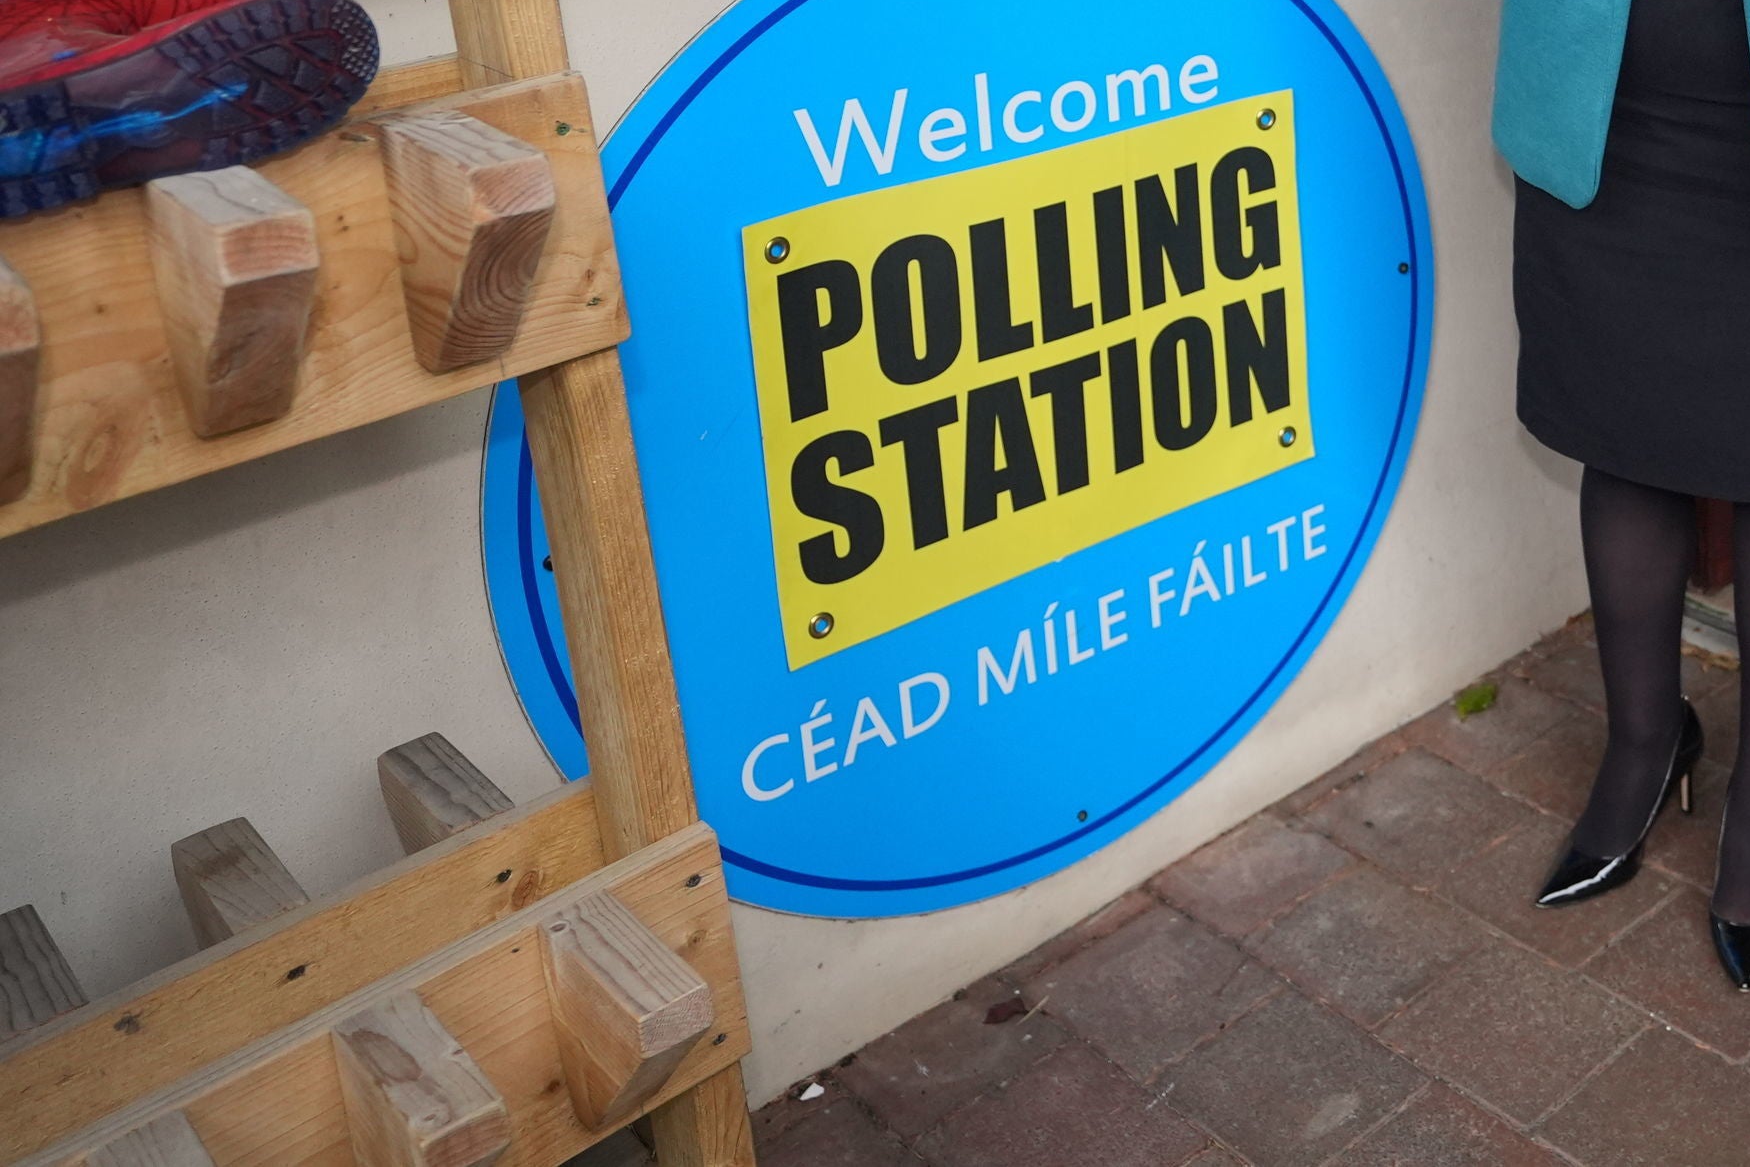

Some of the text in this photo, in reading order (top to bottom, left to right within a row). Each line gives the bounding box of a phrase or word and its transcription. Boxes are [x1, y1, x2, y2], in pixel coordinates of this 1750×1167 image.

[793, 53, 1219, 188] Welcome
[776, 146, 1281, 423] POLLING
[790, 287, 1291, 585] STATION
[741, 503, 1327, 802] CÉAD MÍLE FÁILTE
